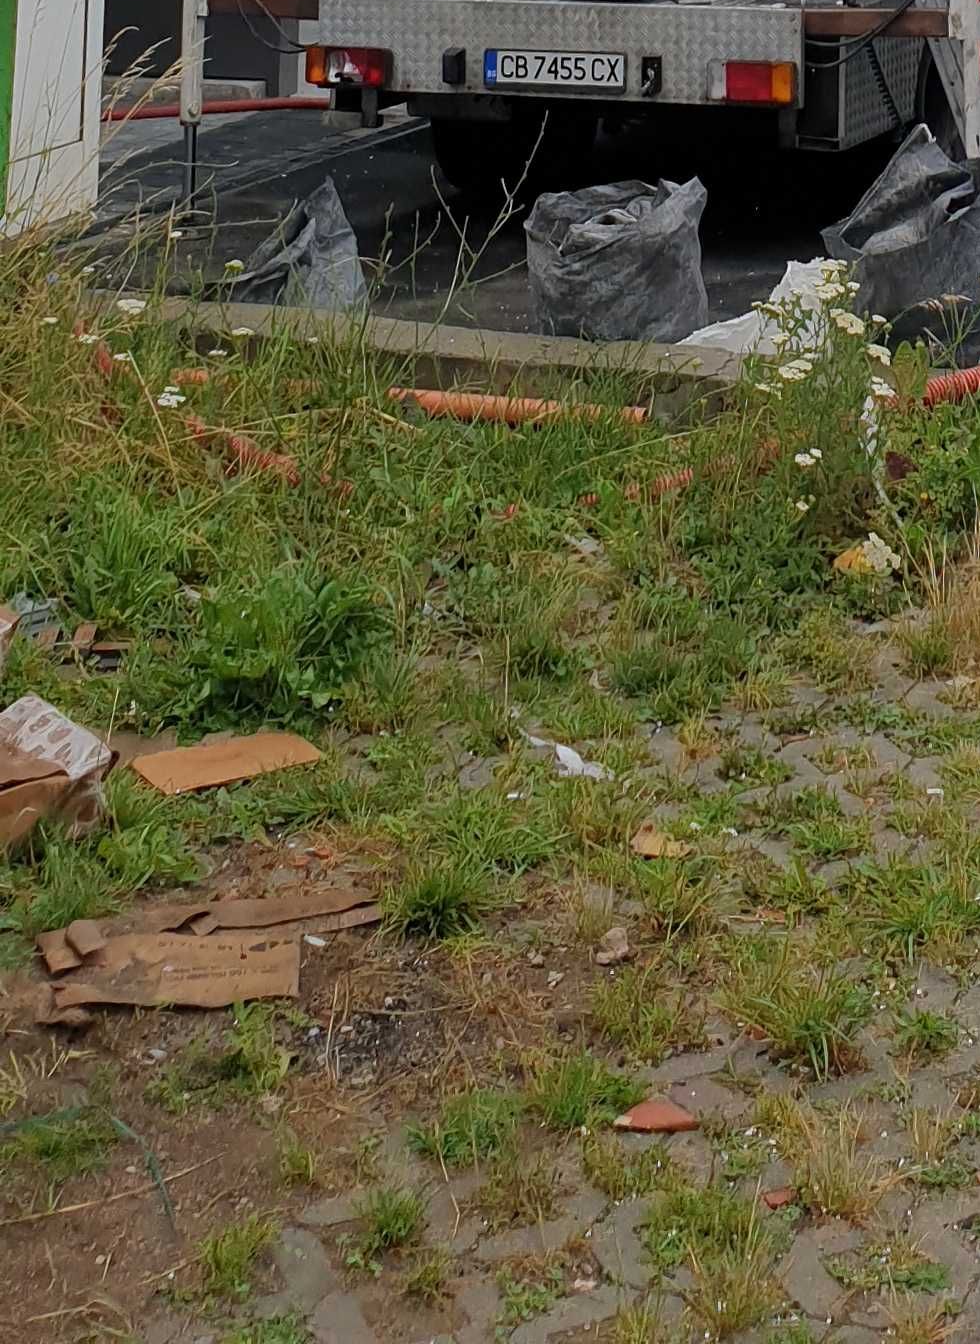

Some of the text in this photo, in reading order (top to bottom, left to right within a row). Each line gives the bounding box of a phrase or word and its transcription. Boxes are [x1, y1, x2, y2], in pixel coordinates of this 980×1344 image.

[501, 55, 528, 78] CB
[534, 56, 586, 80] 7455
[591, 58, 620, 82] CX
